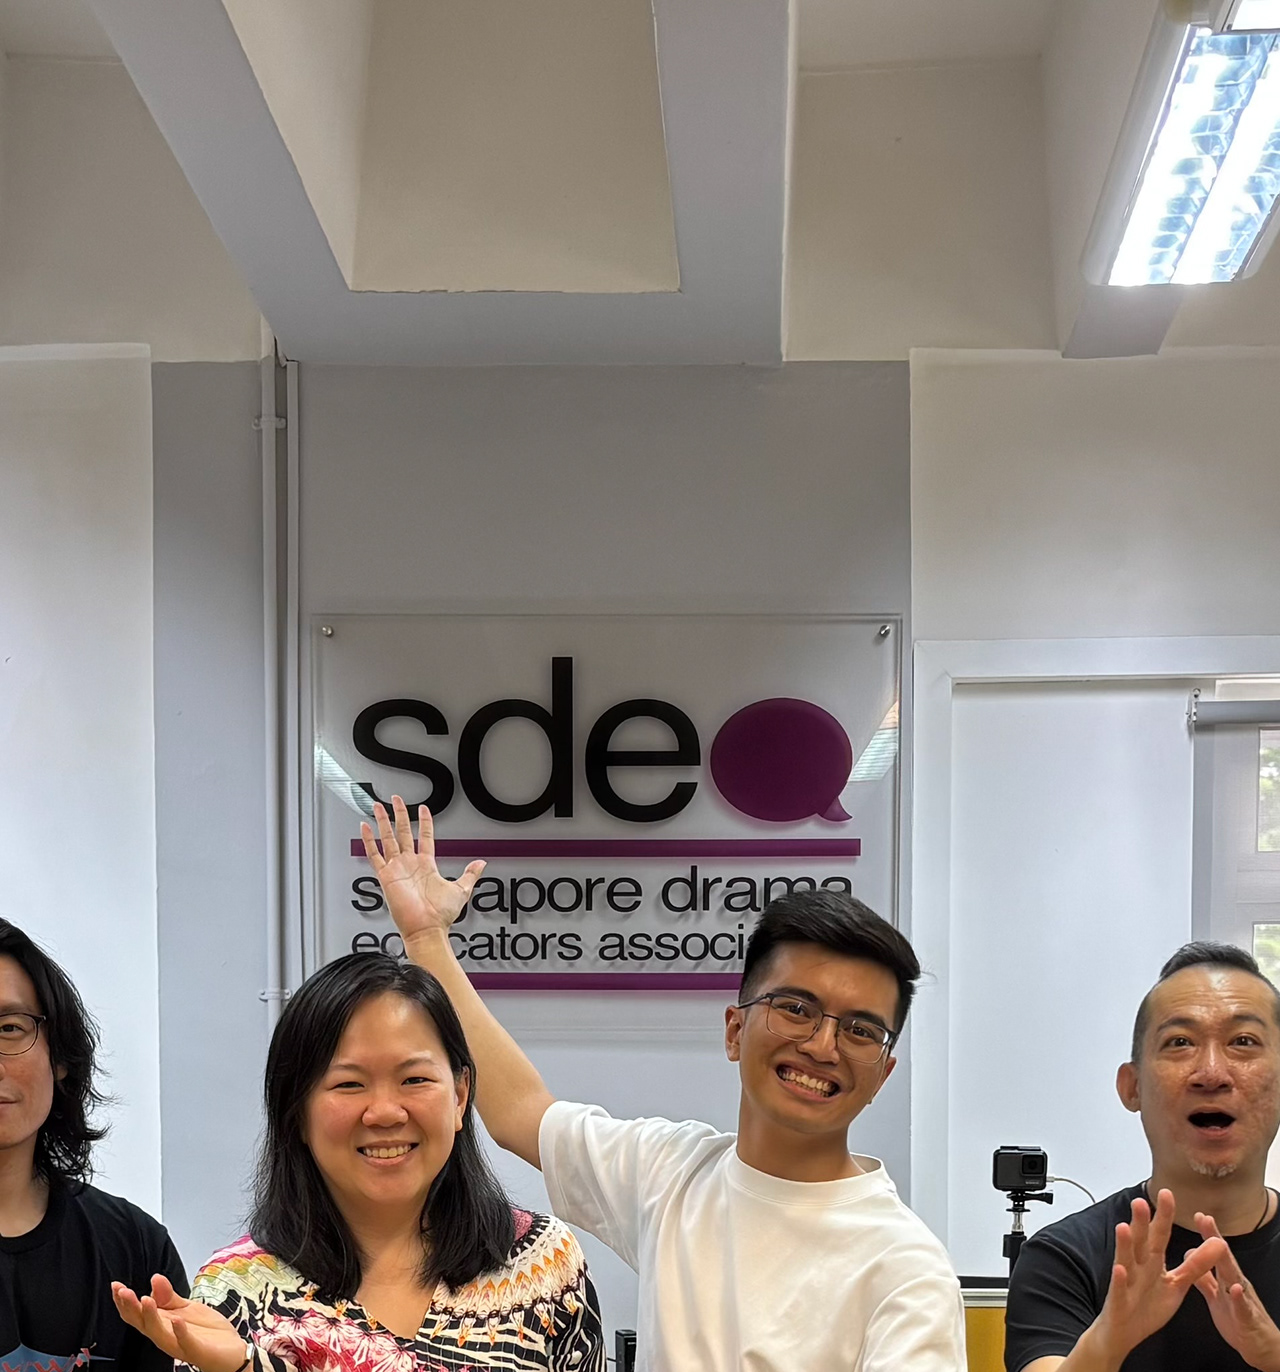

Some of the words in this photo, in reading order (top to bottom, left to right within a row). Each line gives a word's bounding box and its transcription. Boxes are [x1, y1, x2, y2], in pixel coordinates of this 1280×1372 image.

[351, 875, 642, 924] sapore
[351, 926, 583, 961] ecators
[598, 923, 745, 961] associ
